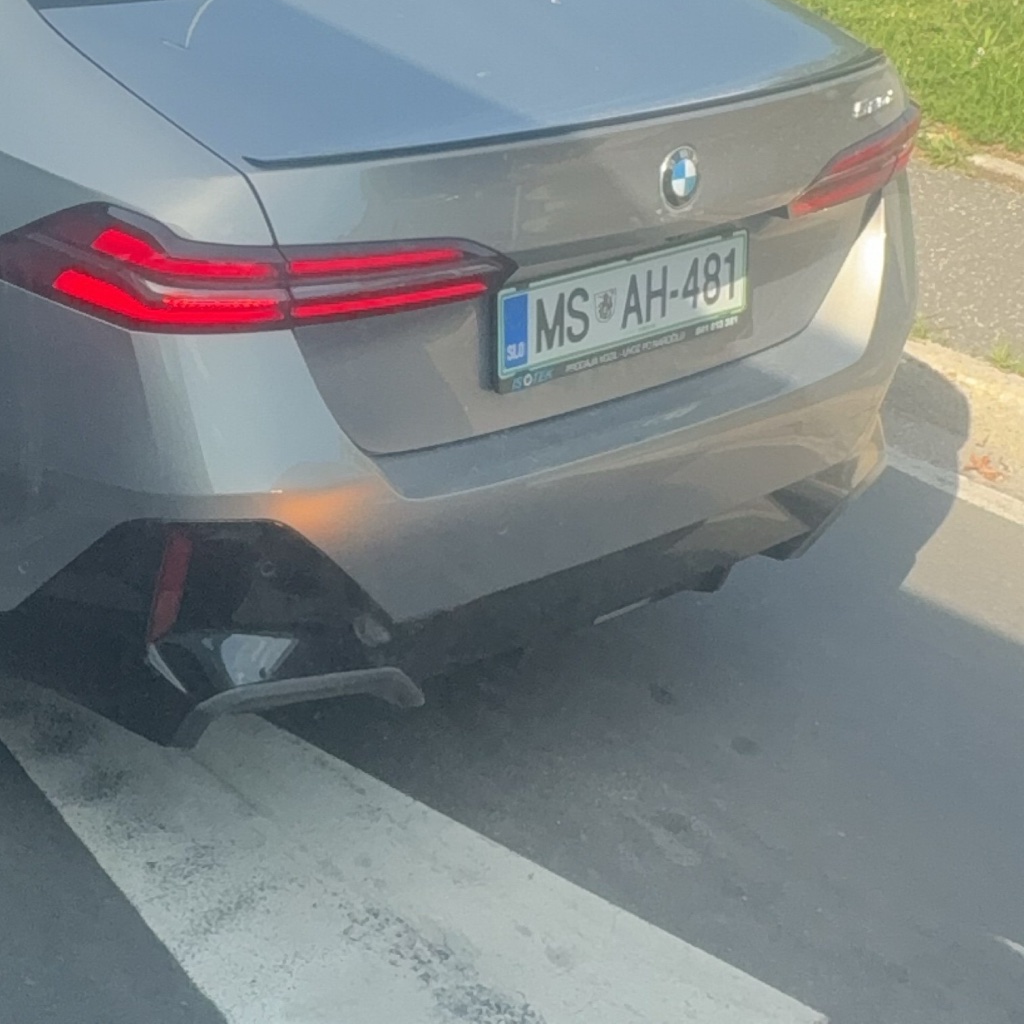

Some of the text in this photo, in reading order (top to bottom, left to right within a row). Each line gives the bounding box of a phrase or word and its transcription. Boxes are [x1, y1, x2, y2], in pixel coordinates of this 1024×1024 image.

[535, 247, 736, 354] MS AH-481
[506, 341, 526, 362] SLO
